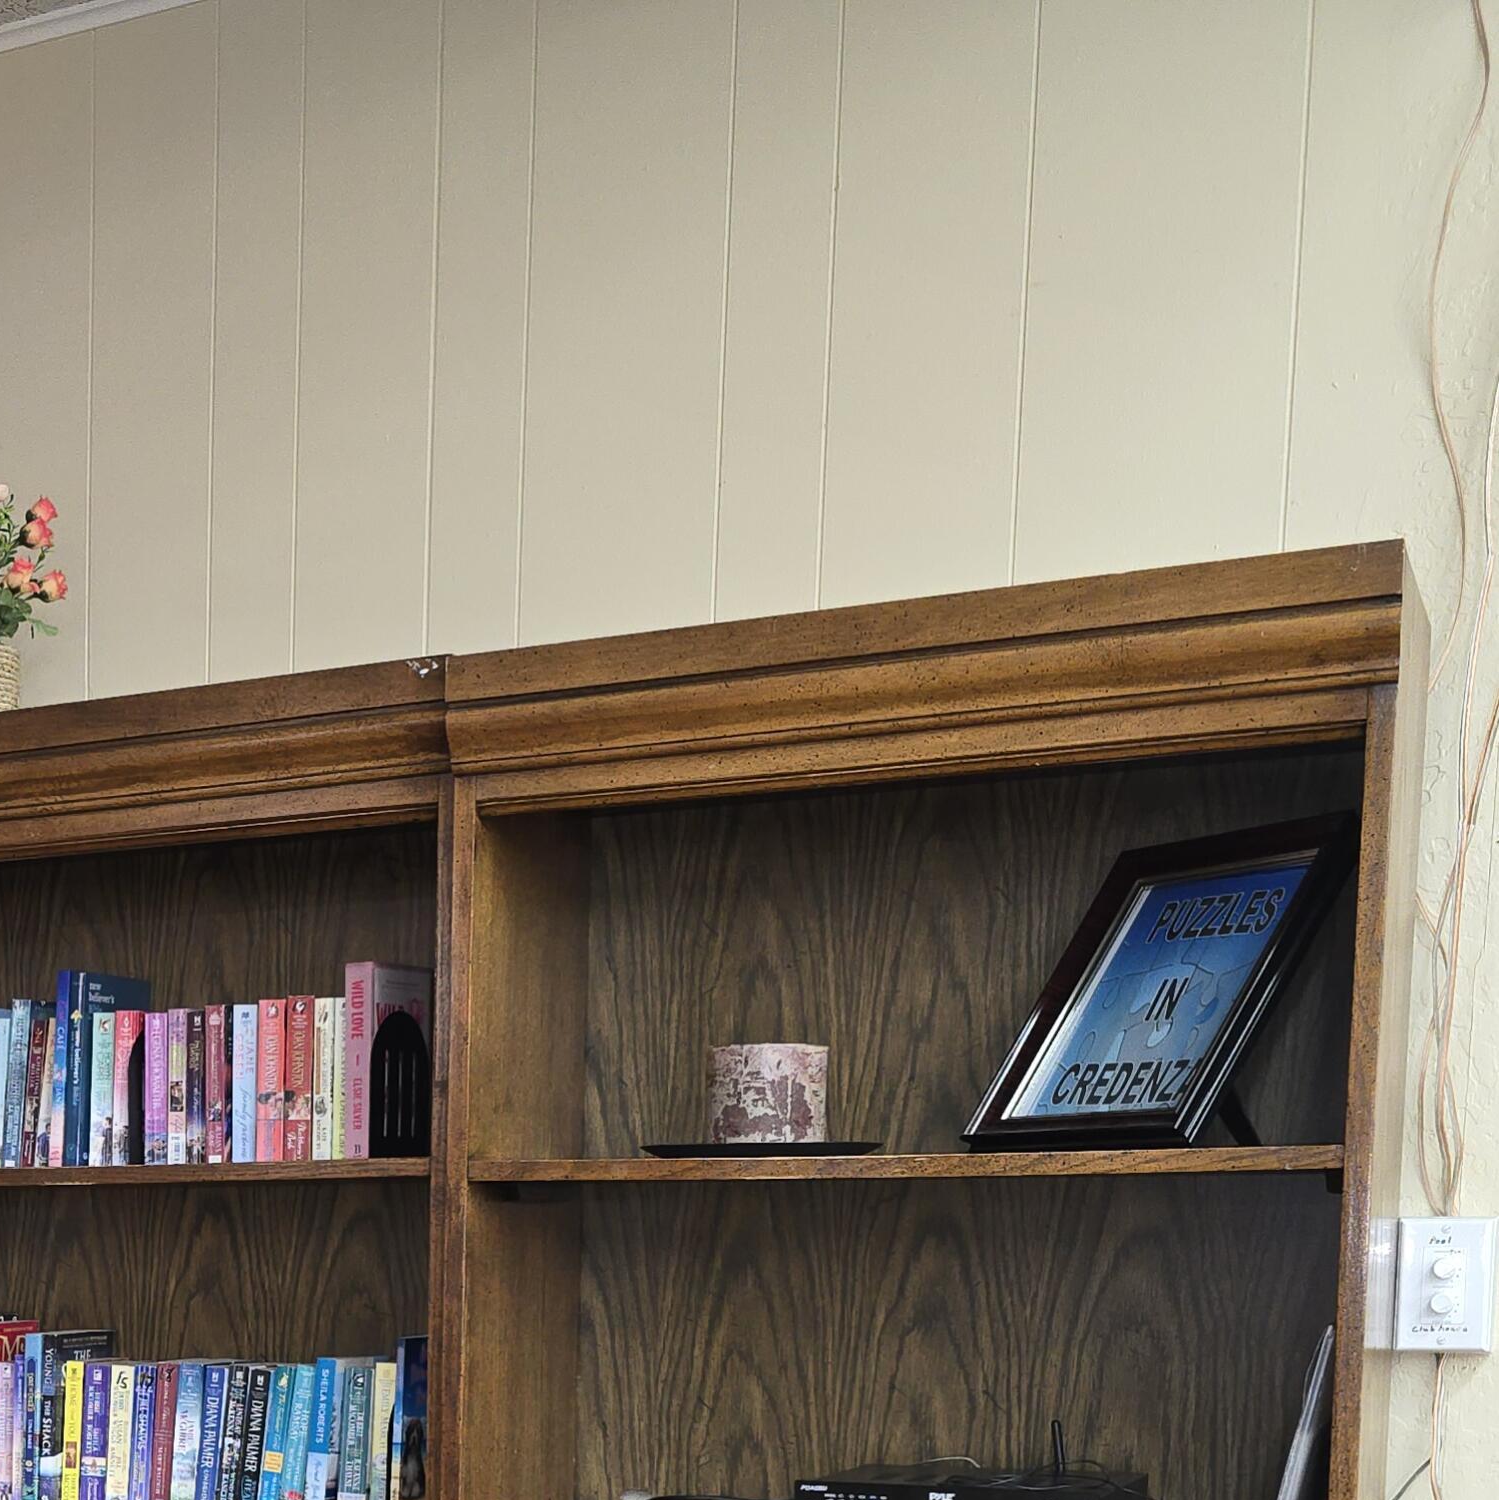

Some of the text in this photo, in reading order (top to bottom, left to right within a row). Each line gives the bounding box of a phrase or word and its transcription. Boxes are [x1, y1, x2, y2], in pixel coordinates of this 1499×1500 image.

[1147, 887, 1284, 944] PUZZLES
[351, 980, 364, 1009] WILD
[1145, 978, 1189, 1021] IN
[351, 1012, 362, 1039] LOVE
[353, 1103, 362, 1130] SILVER
[44, 1348, 54, 1384] YOUNG
[315, 1369, 330, 1444] SHEILA ROBERTS
[42, 1418, 52, 1456] SHACK
[201, 1397, 218, 1468] DIANA PALMER
[244, 1400, 263, 1472] DIANA PALMER
